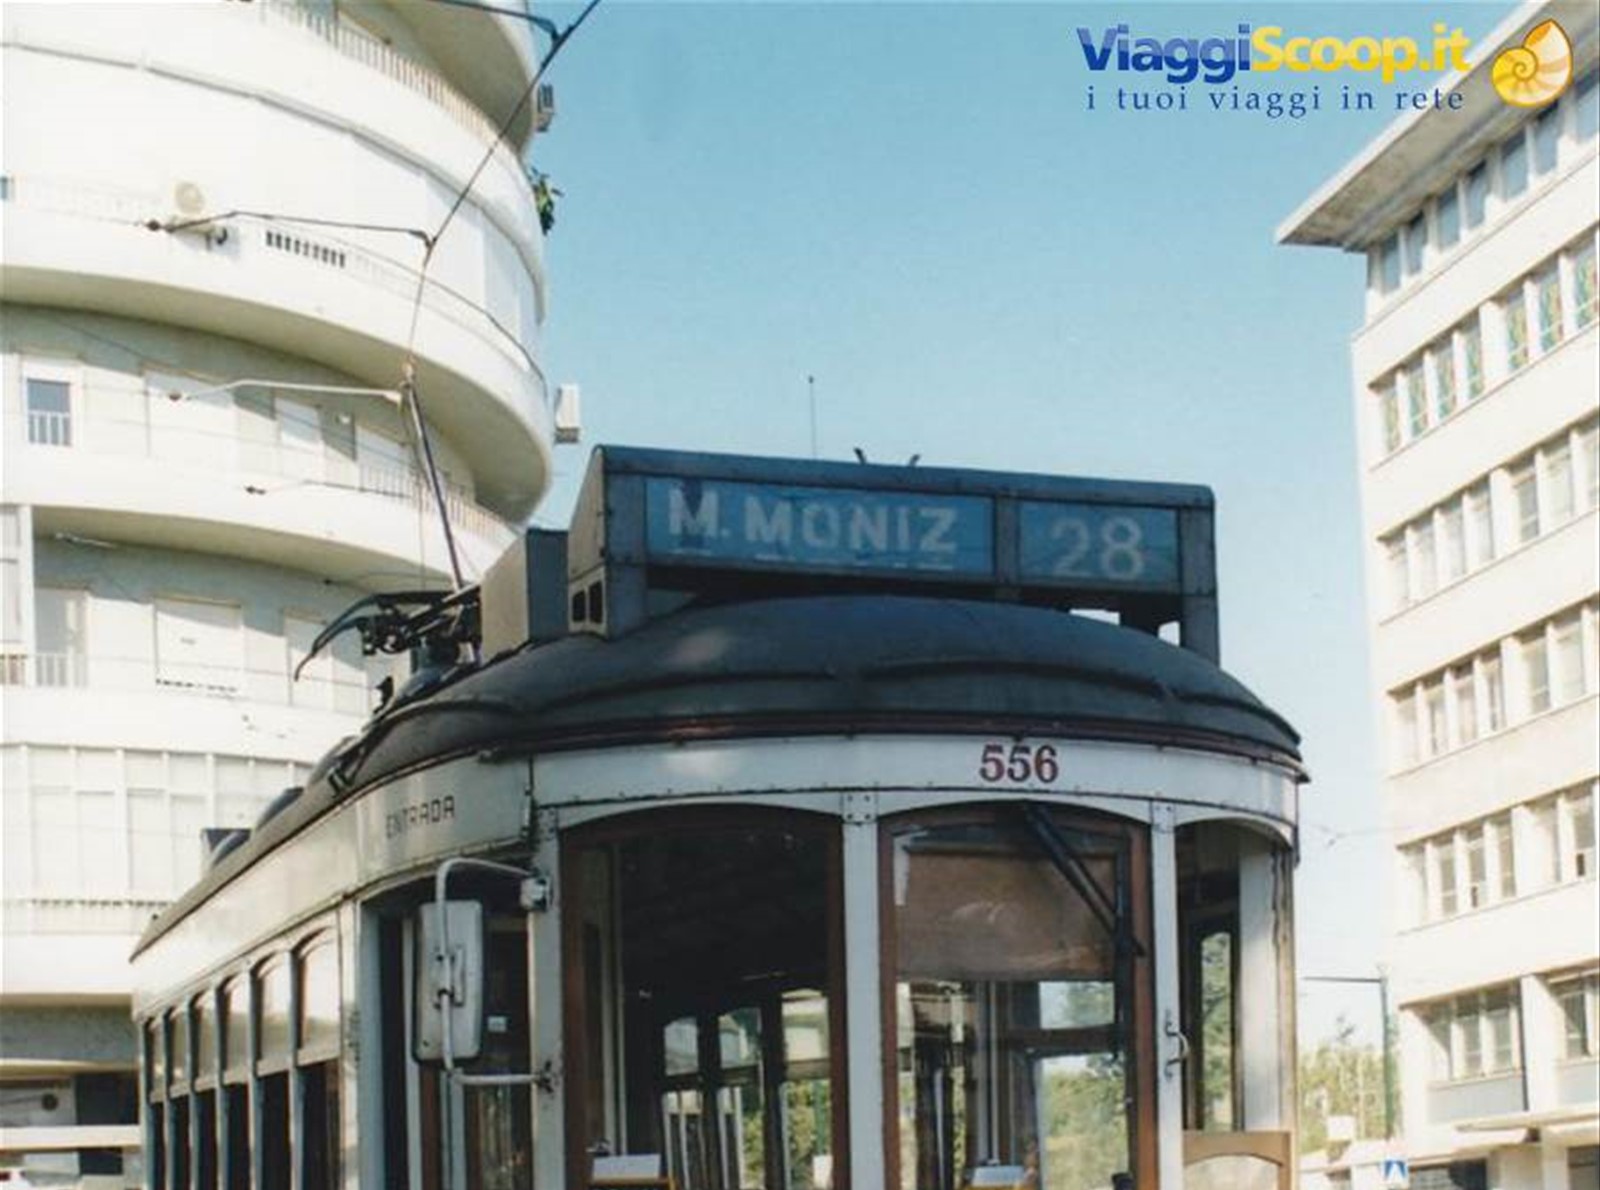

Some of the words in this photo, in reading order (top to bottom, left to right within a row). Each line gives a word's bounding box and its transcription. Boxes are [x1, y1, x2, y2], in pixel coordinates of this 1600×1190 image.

[667, 485, 730, 538] M.
[744, 494, 958, 553] MONIZ
[1049, 515, 1145, 581] 28
[979, 743, 1060, 784] 556
[386, 795, 455, 840] ENTRADA
